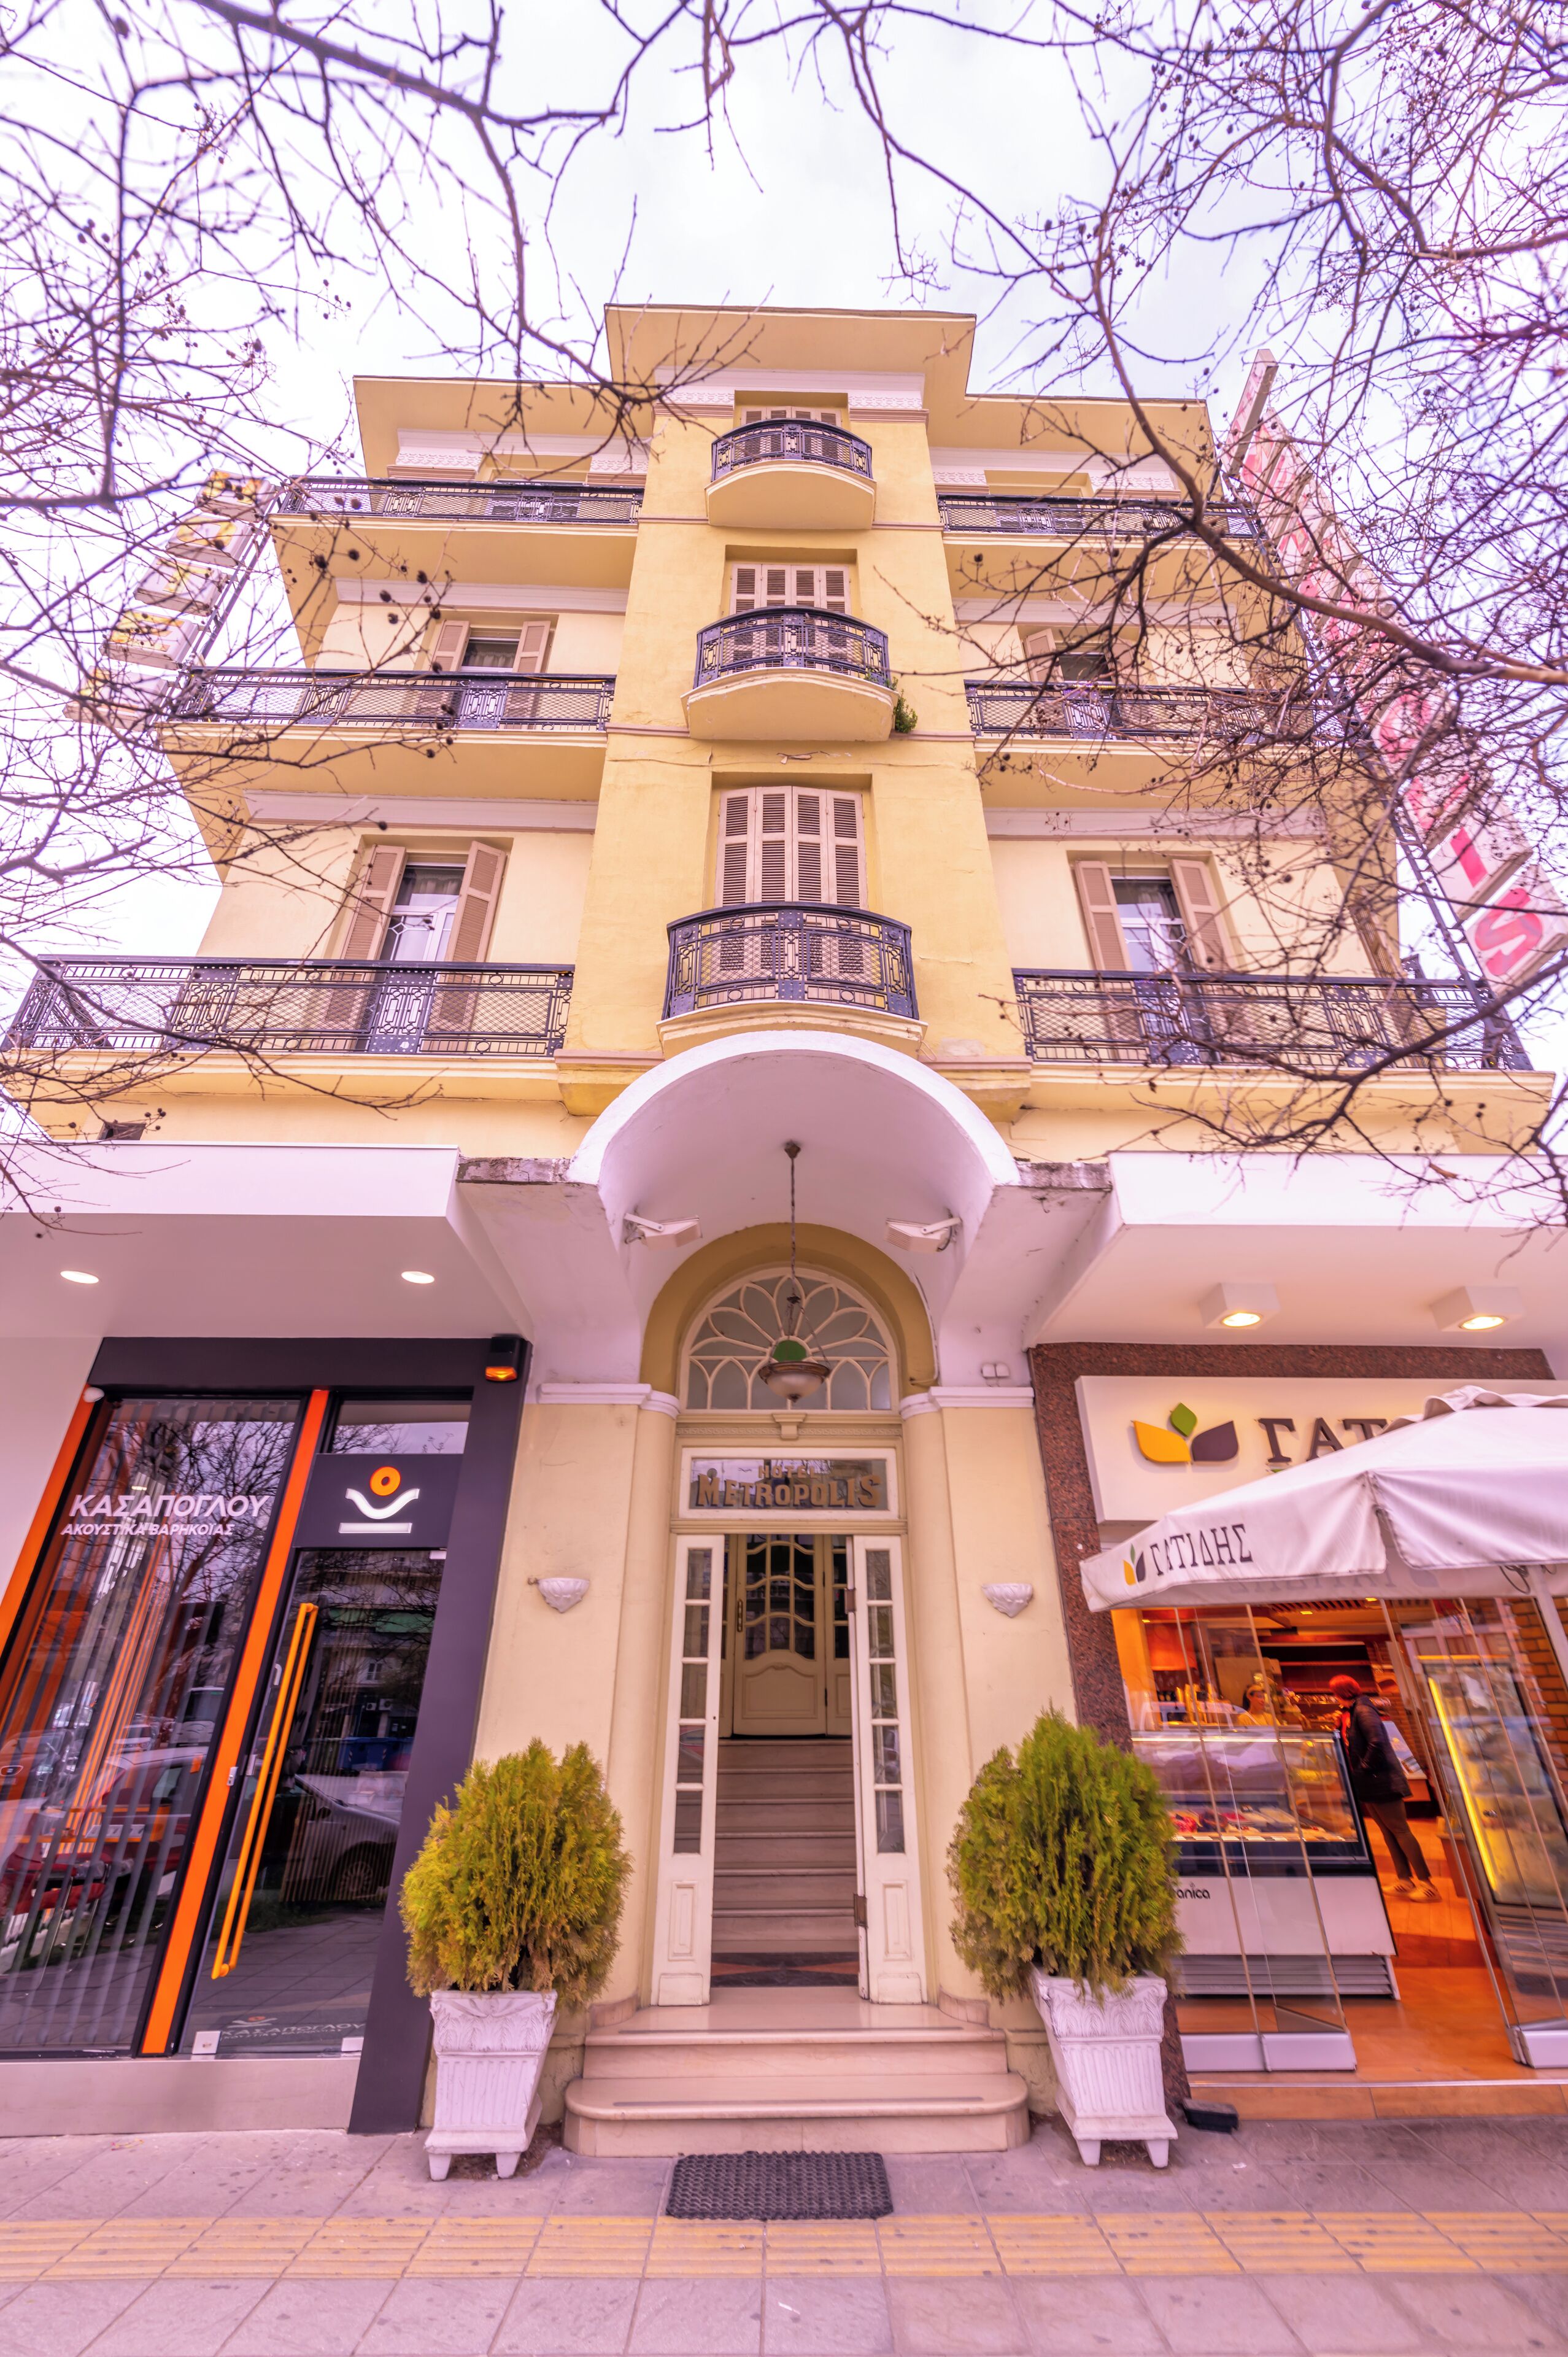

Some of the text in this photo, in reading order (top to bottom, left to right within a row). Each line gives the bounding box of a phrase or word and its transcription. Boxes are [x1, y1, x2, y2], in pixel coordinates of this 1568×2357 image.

[758, 1465, 817, 1479] HOTEL
[695, 1473, 882, 1507] METROPOLIS
[68, 1495, 271, 1517] ΚΑΣΑΠΟΓΛΟΥ
[60, 1523, 146, 1535] ΑΚΟΥΣΤΙΚΑ
[1150, 1523, 1253, 1576] ΓΑΤΙΔΗΣ
